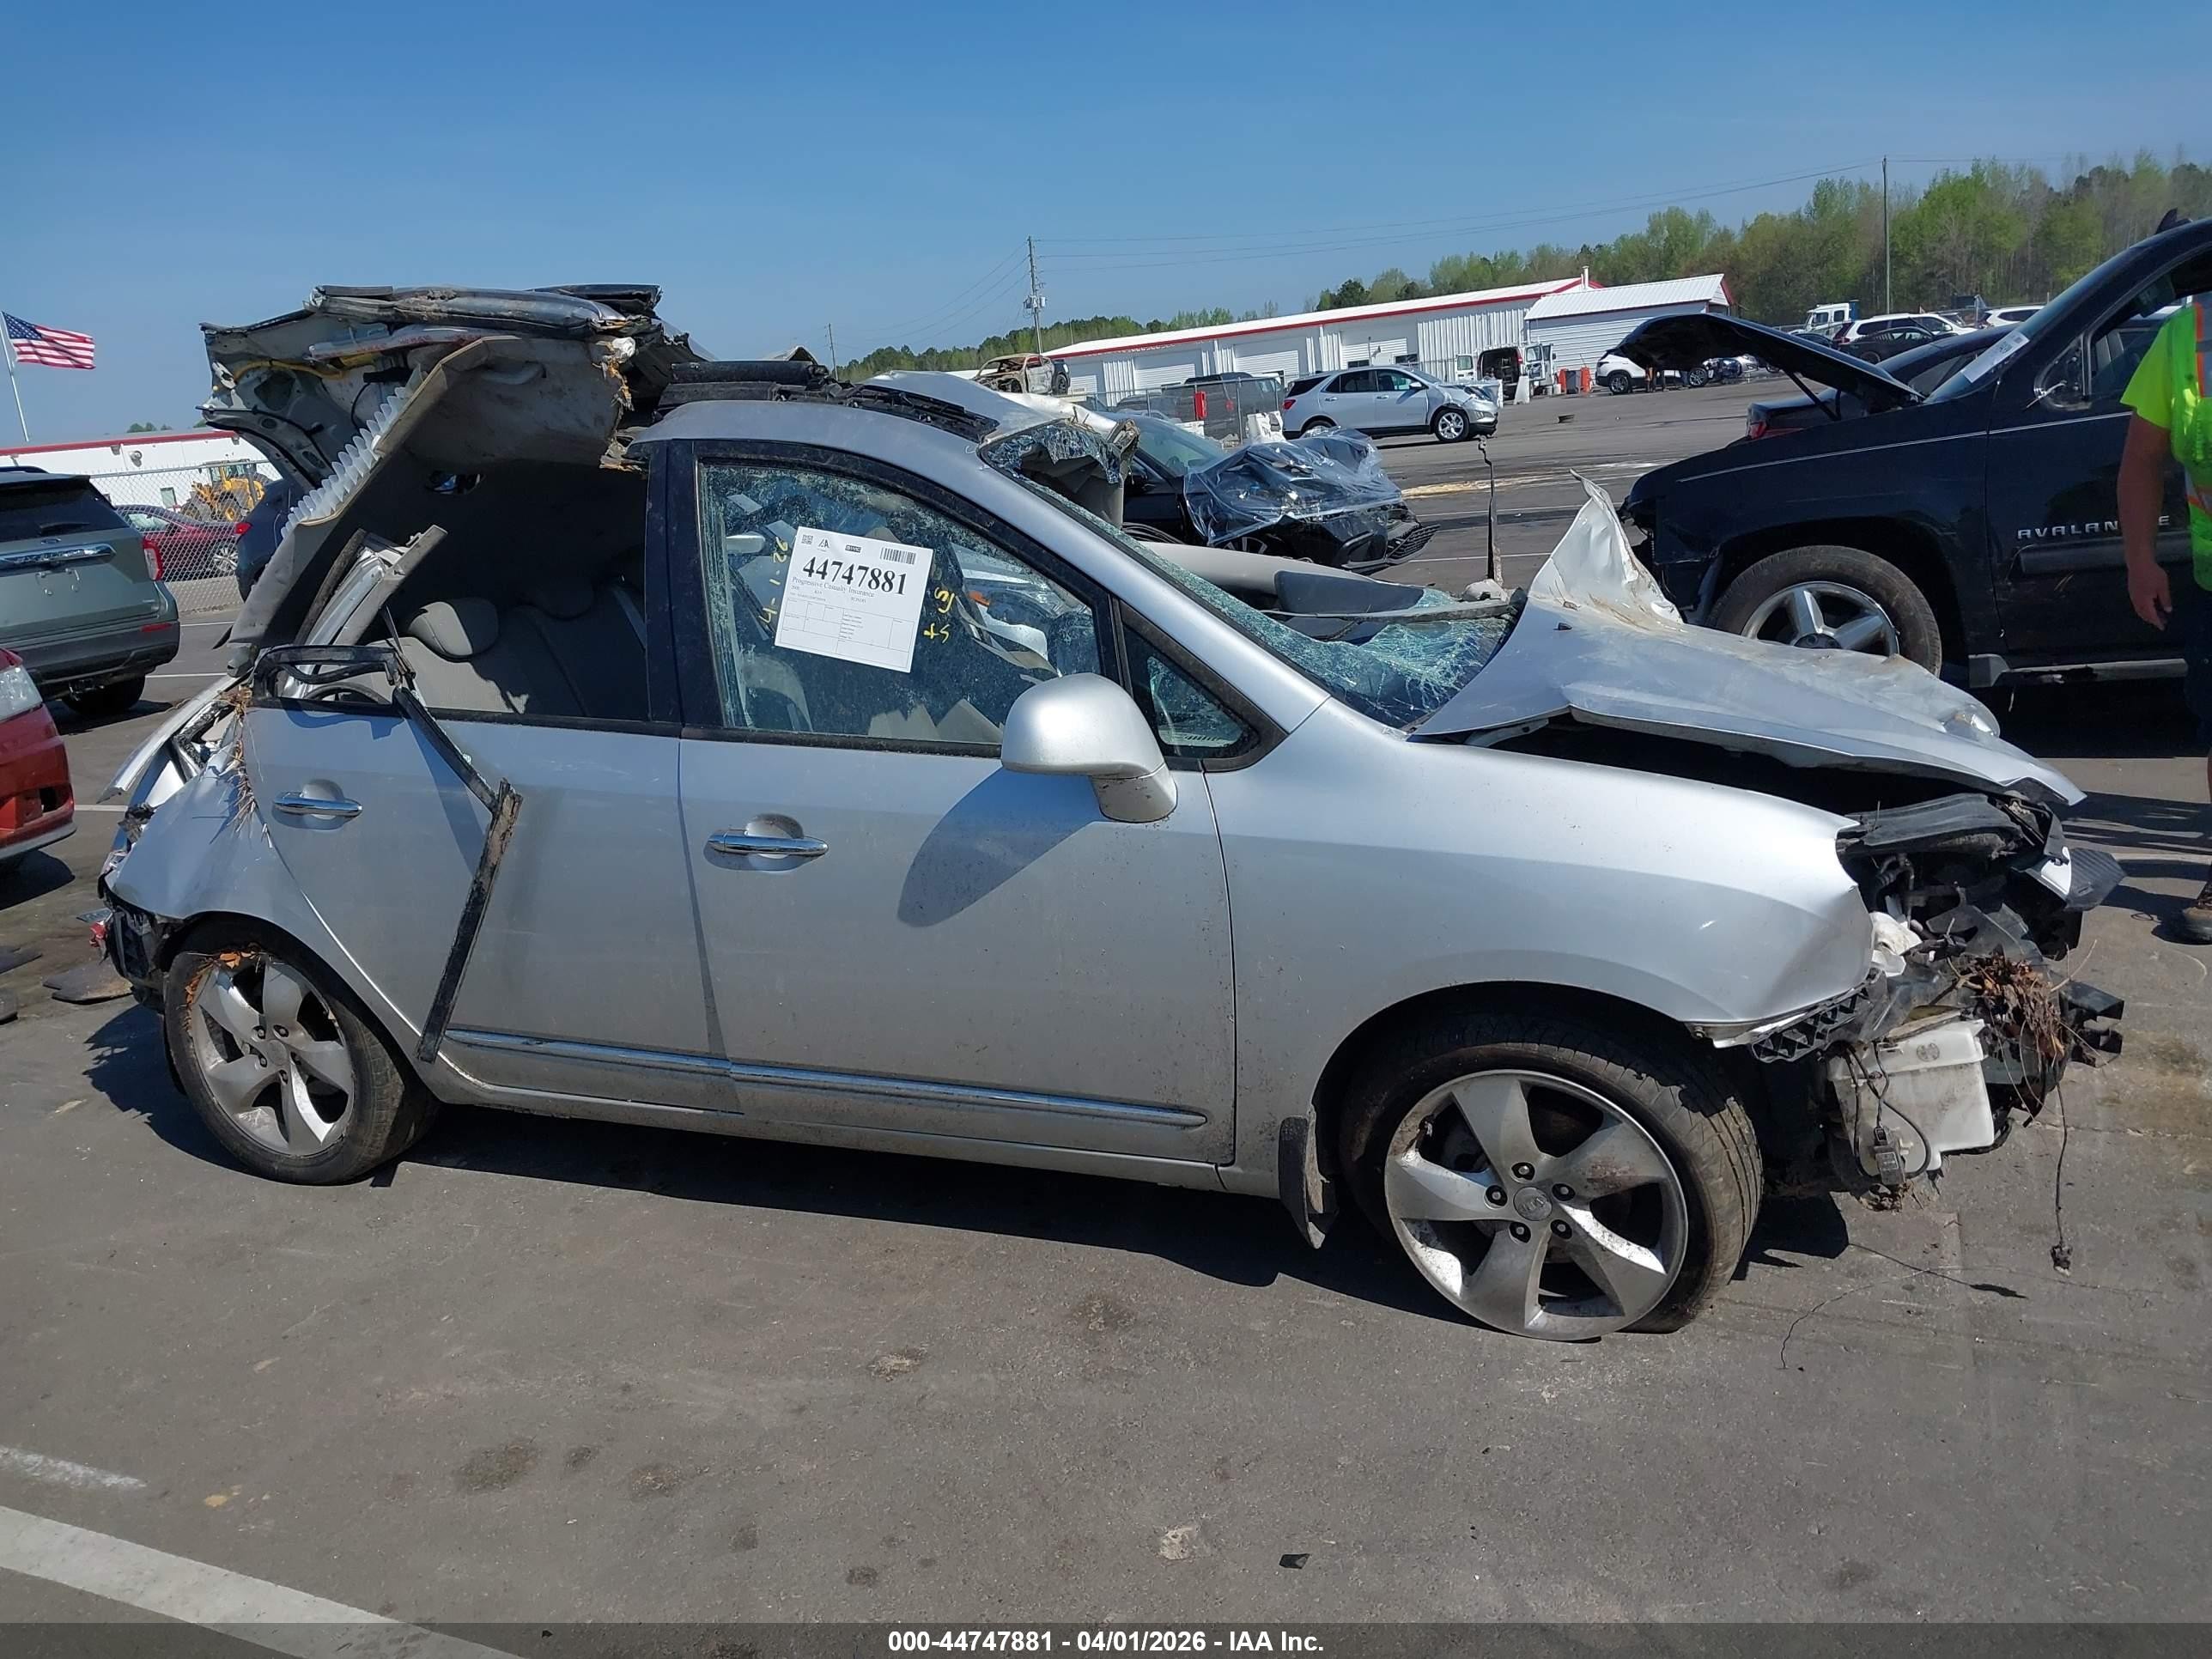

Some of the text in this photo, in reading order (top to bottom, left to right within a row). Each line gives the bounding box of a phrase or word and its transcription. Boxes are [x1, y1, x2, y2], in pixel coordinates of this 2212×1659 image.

[2017, 514, 2171, 540] AVALANE
[792, 576, 823, 588] Progressive
[823, 583, 847, 594] Casualty
[848, 587, 875, 598] Insurance
[802, 556, 907, 595] 44747881
